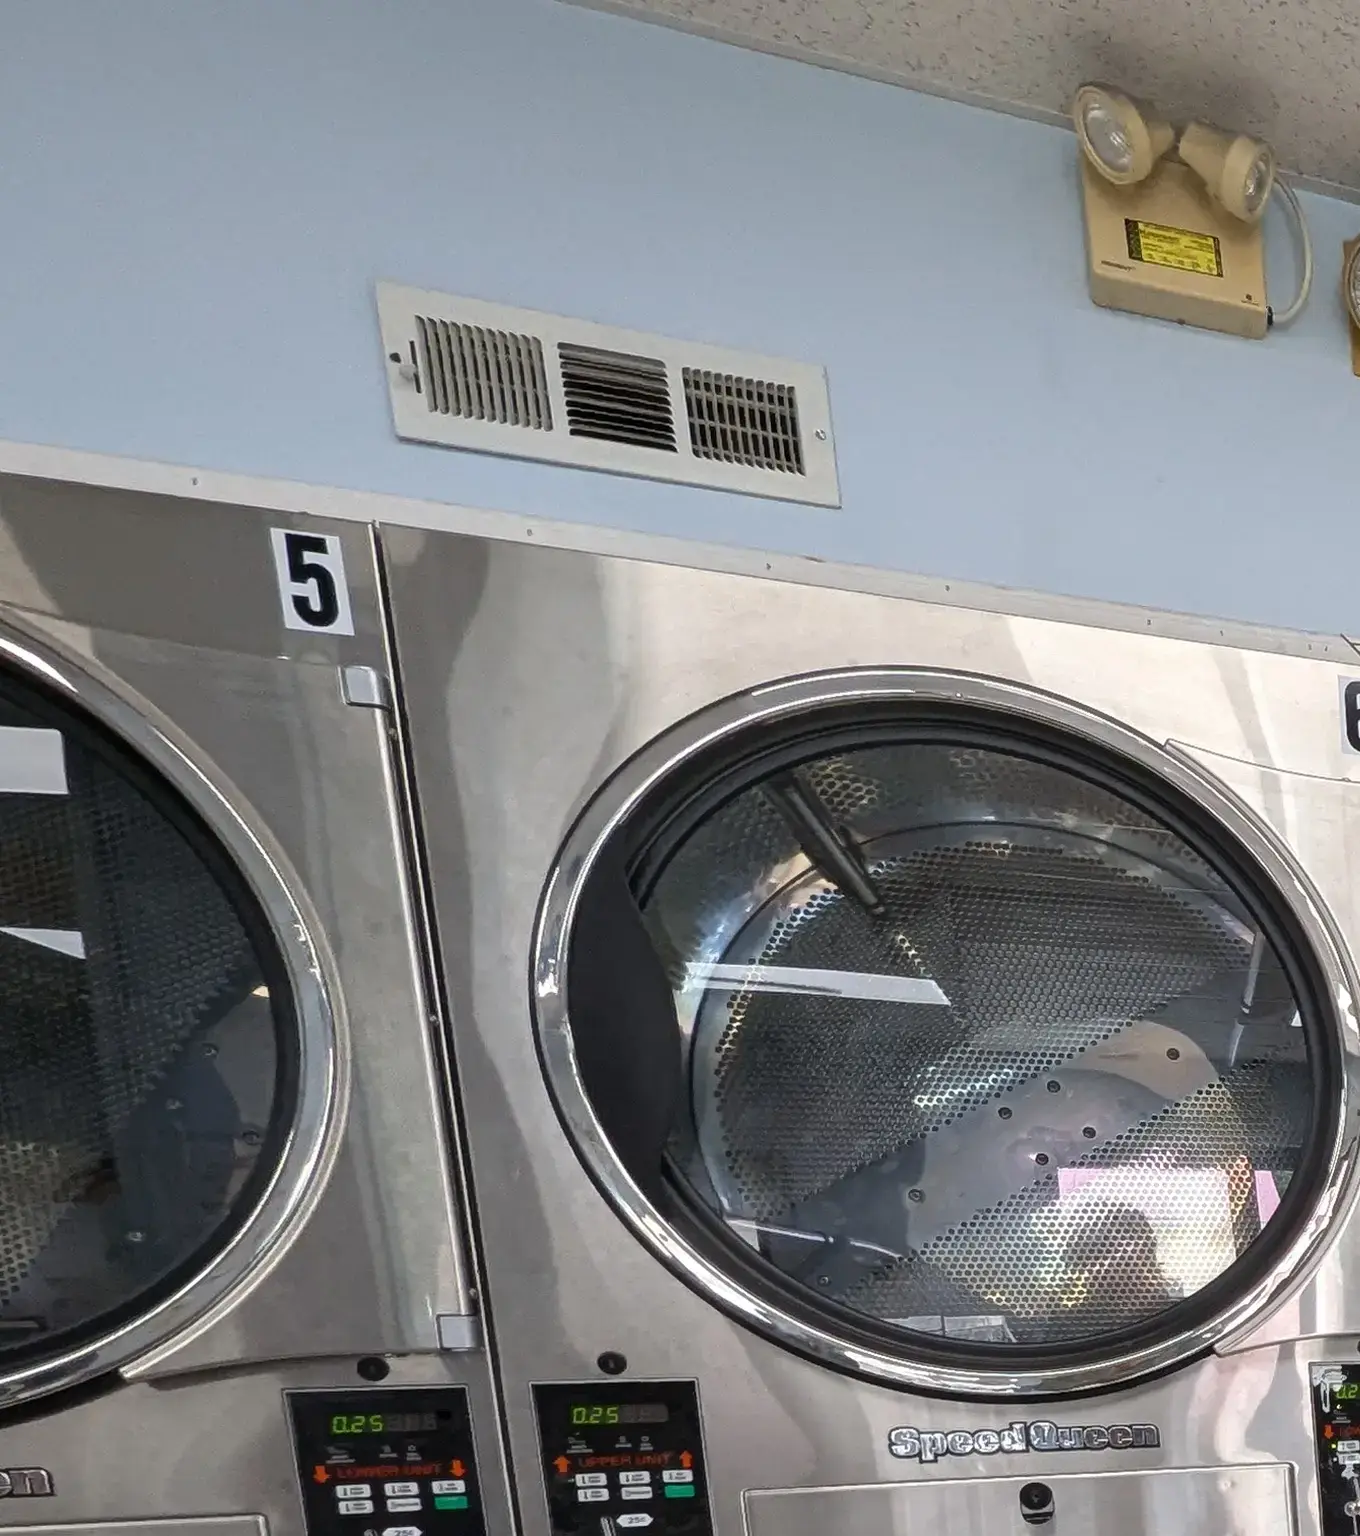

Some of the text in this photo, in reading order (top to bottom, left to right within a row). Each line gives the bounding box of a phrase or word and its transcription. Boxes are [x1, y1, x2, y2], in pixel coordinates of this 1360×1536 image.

[285, 533, 340, 627] 5
[332, 1414, 384, 1433] 0.25
[573, 1406, 619, 1424] 0.25
[889, 1420, 1160, 1463] Speed Queen
